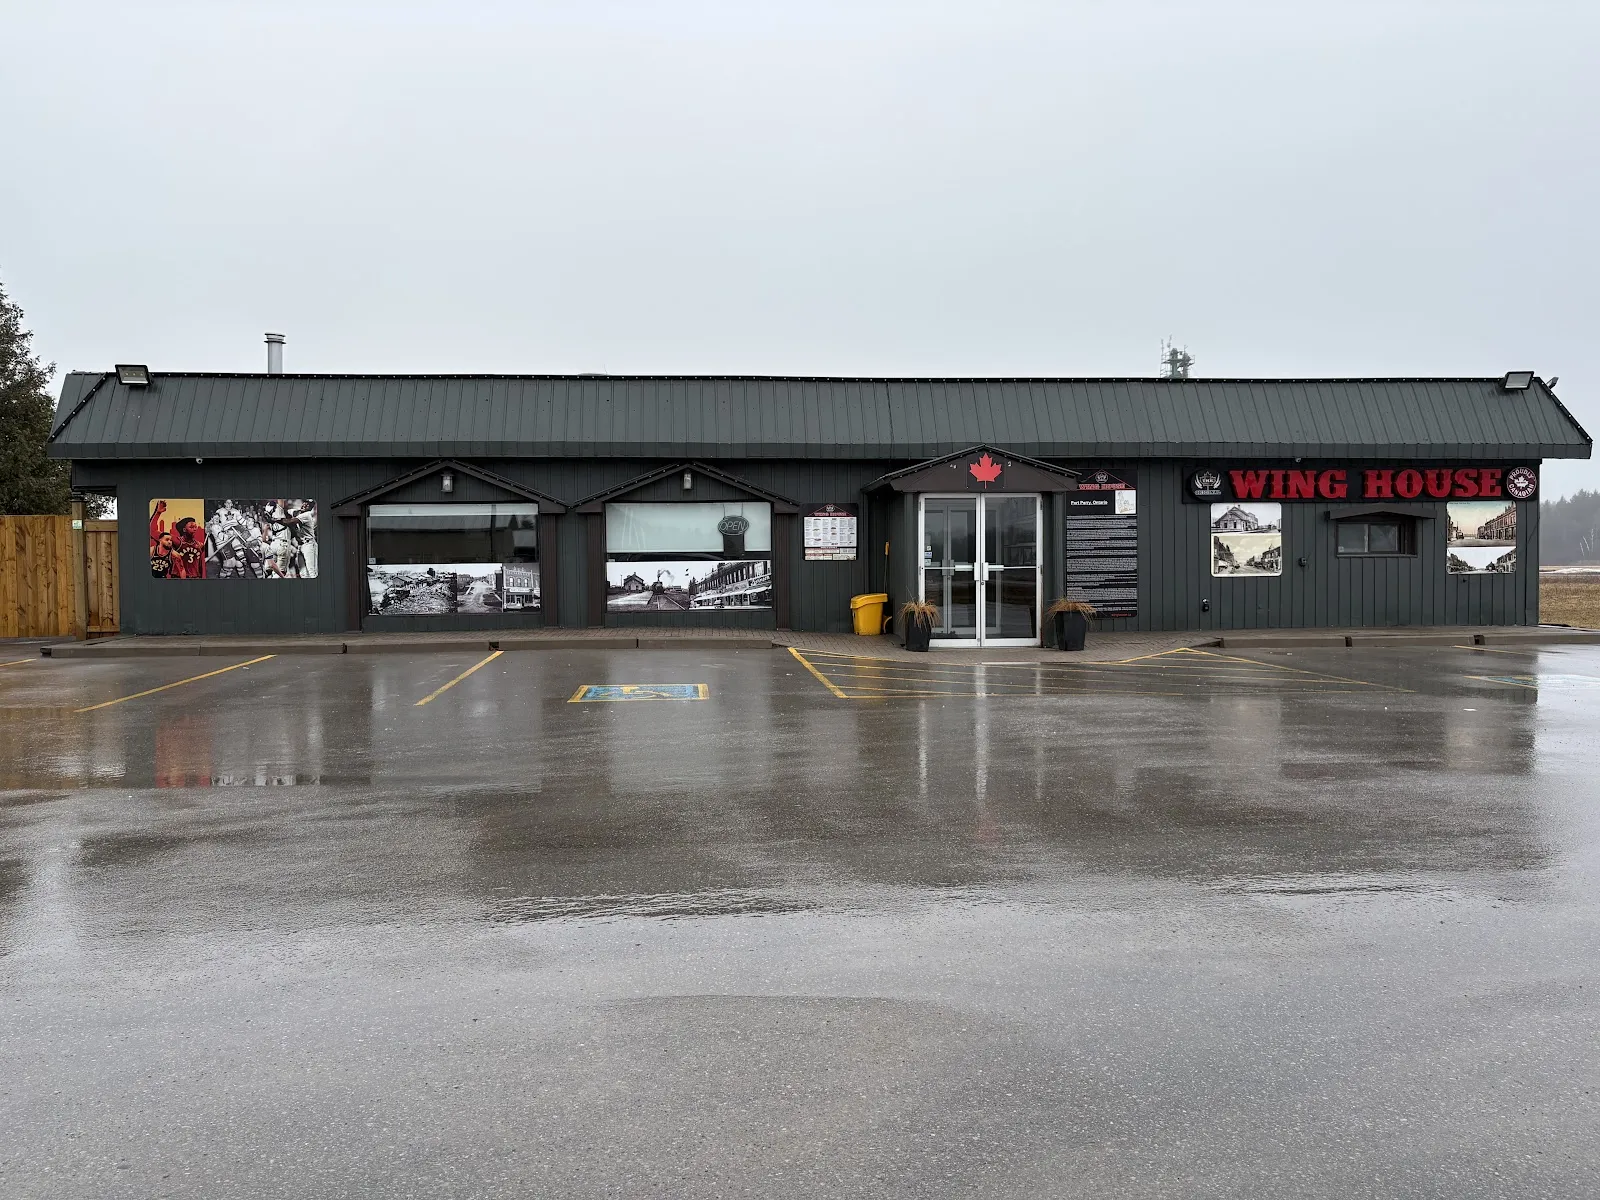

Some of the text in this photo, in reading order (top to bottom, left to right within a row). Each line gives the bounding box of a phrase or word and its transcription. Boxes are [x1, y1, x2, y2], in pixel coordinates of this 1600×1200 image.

[1509, 468, 1534, 480] PROUDLY
[1229, 469, 1502, 499] WING HOUSE
[1508, 483, 1535, 497] CANADIAN
[720, 520, 747, 531] OPEN
[188, 553, 195, 563] 3
[152, 563, 164, 571] 23
